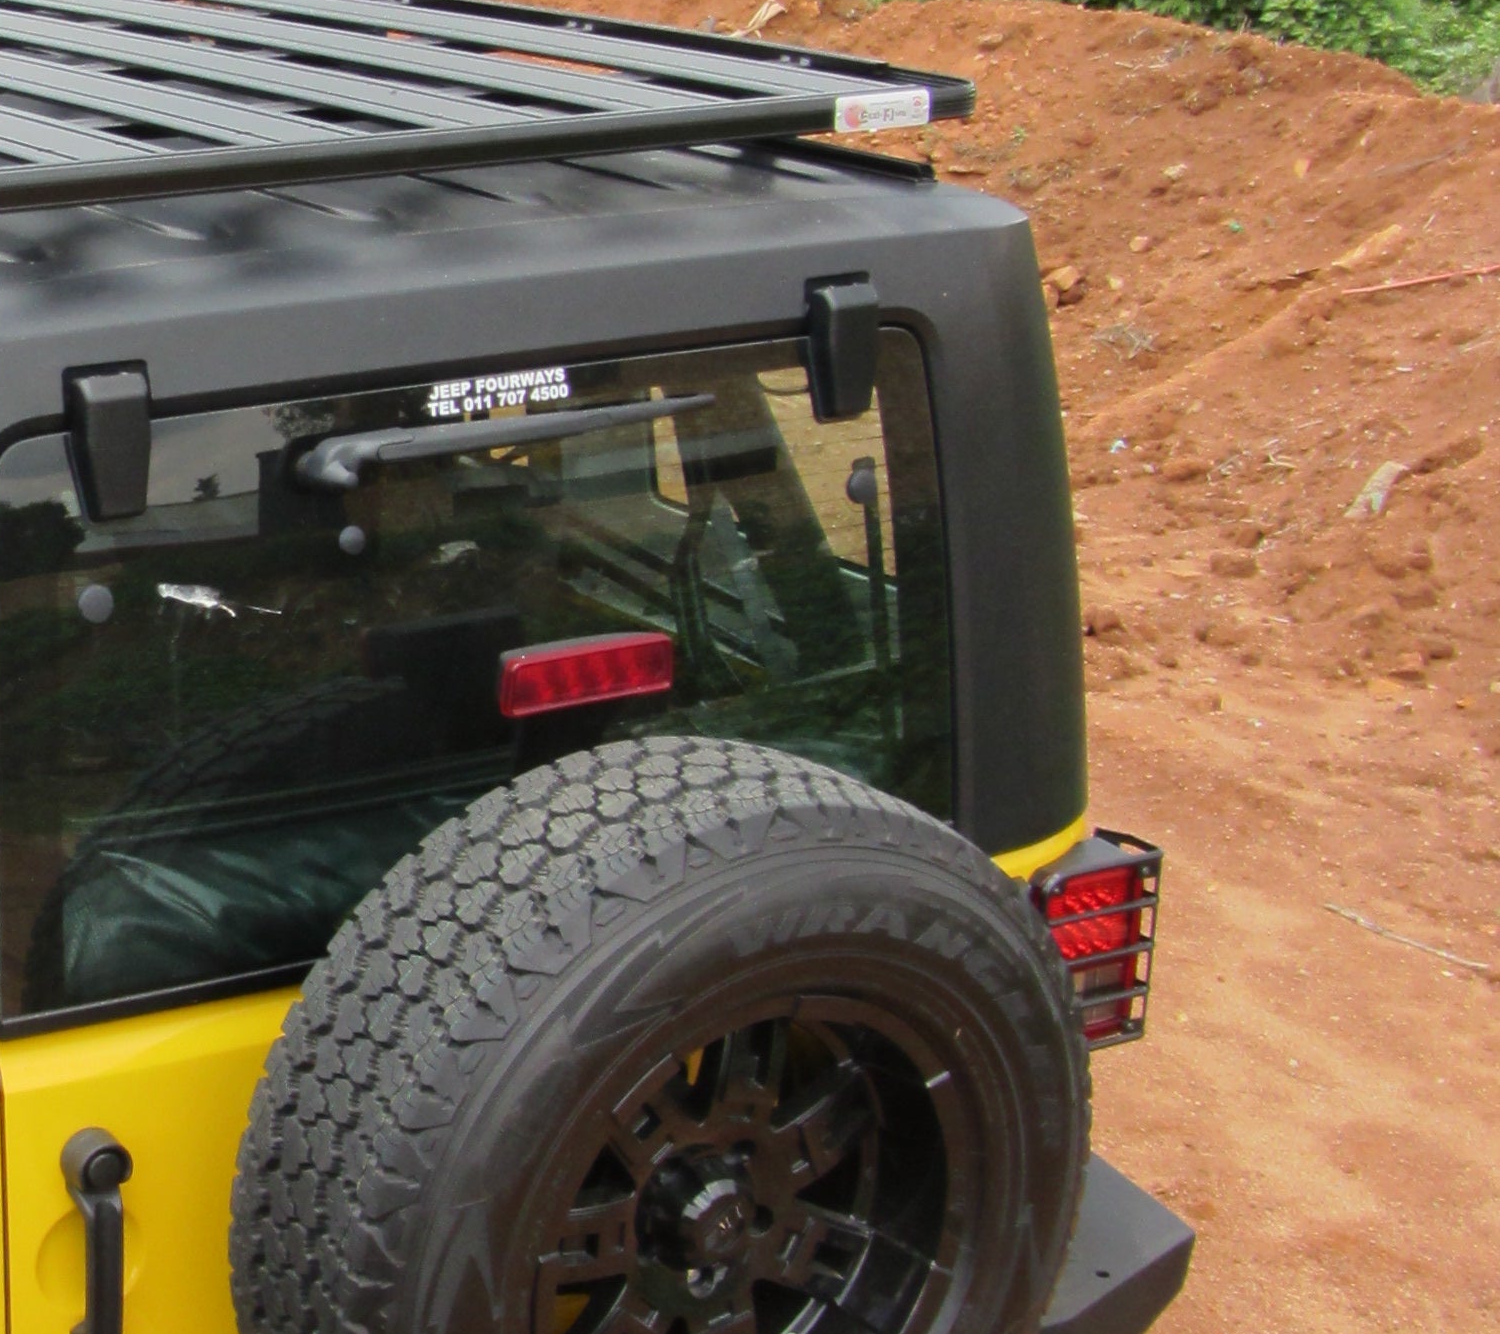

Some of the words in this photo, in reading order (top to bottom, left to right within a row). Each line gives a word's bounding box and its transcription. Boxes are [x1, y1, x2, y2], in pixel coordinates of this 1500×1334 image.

[429, 379, 471, 400] JEEP
[475, 368, 566, 394] FOURWAYS
[428, 400, 460, 417] TEL
[463, 395, 492, 412] 011
[497, 389, 527, 407] 707
[530, 384, 569, 402] 4500
